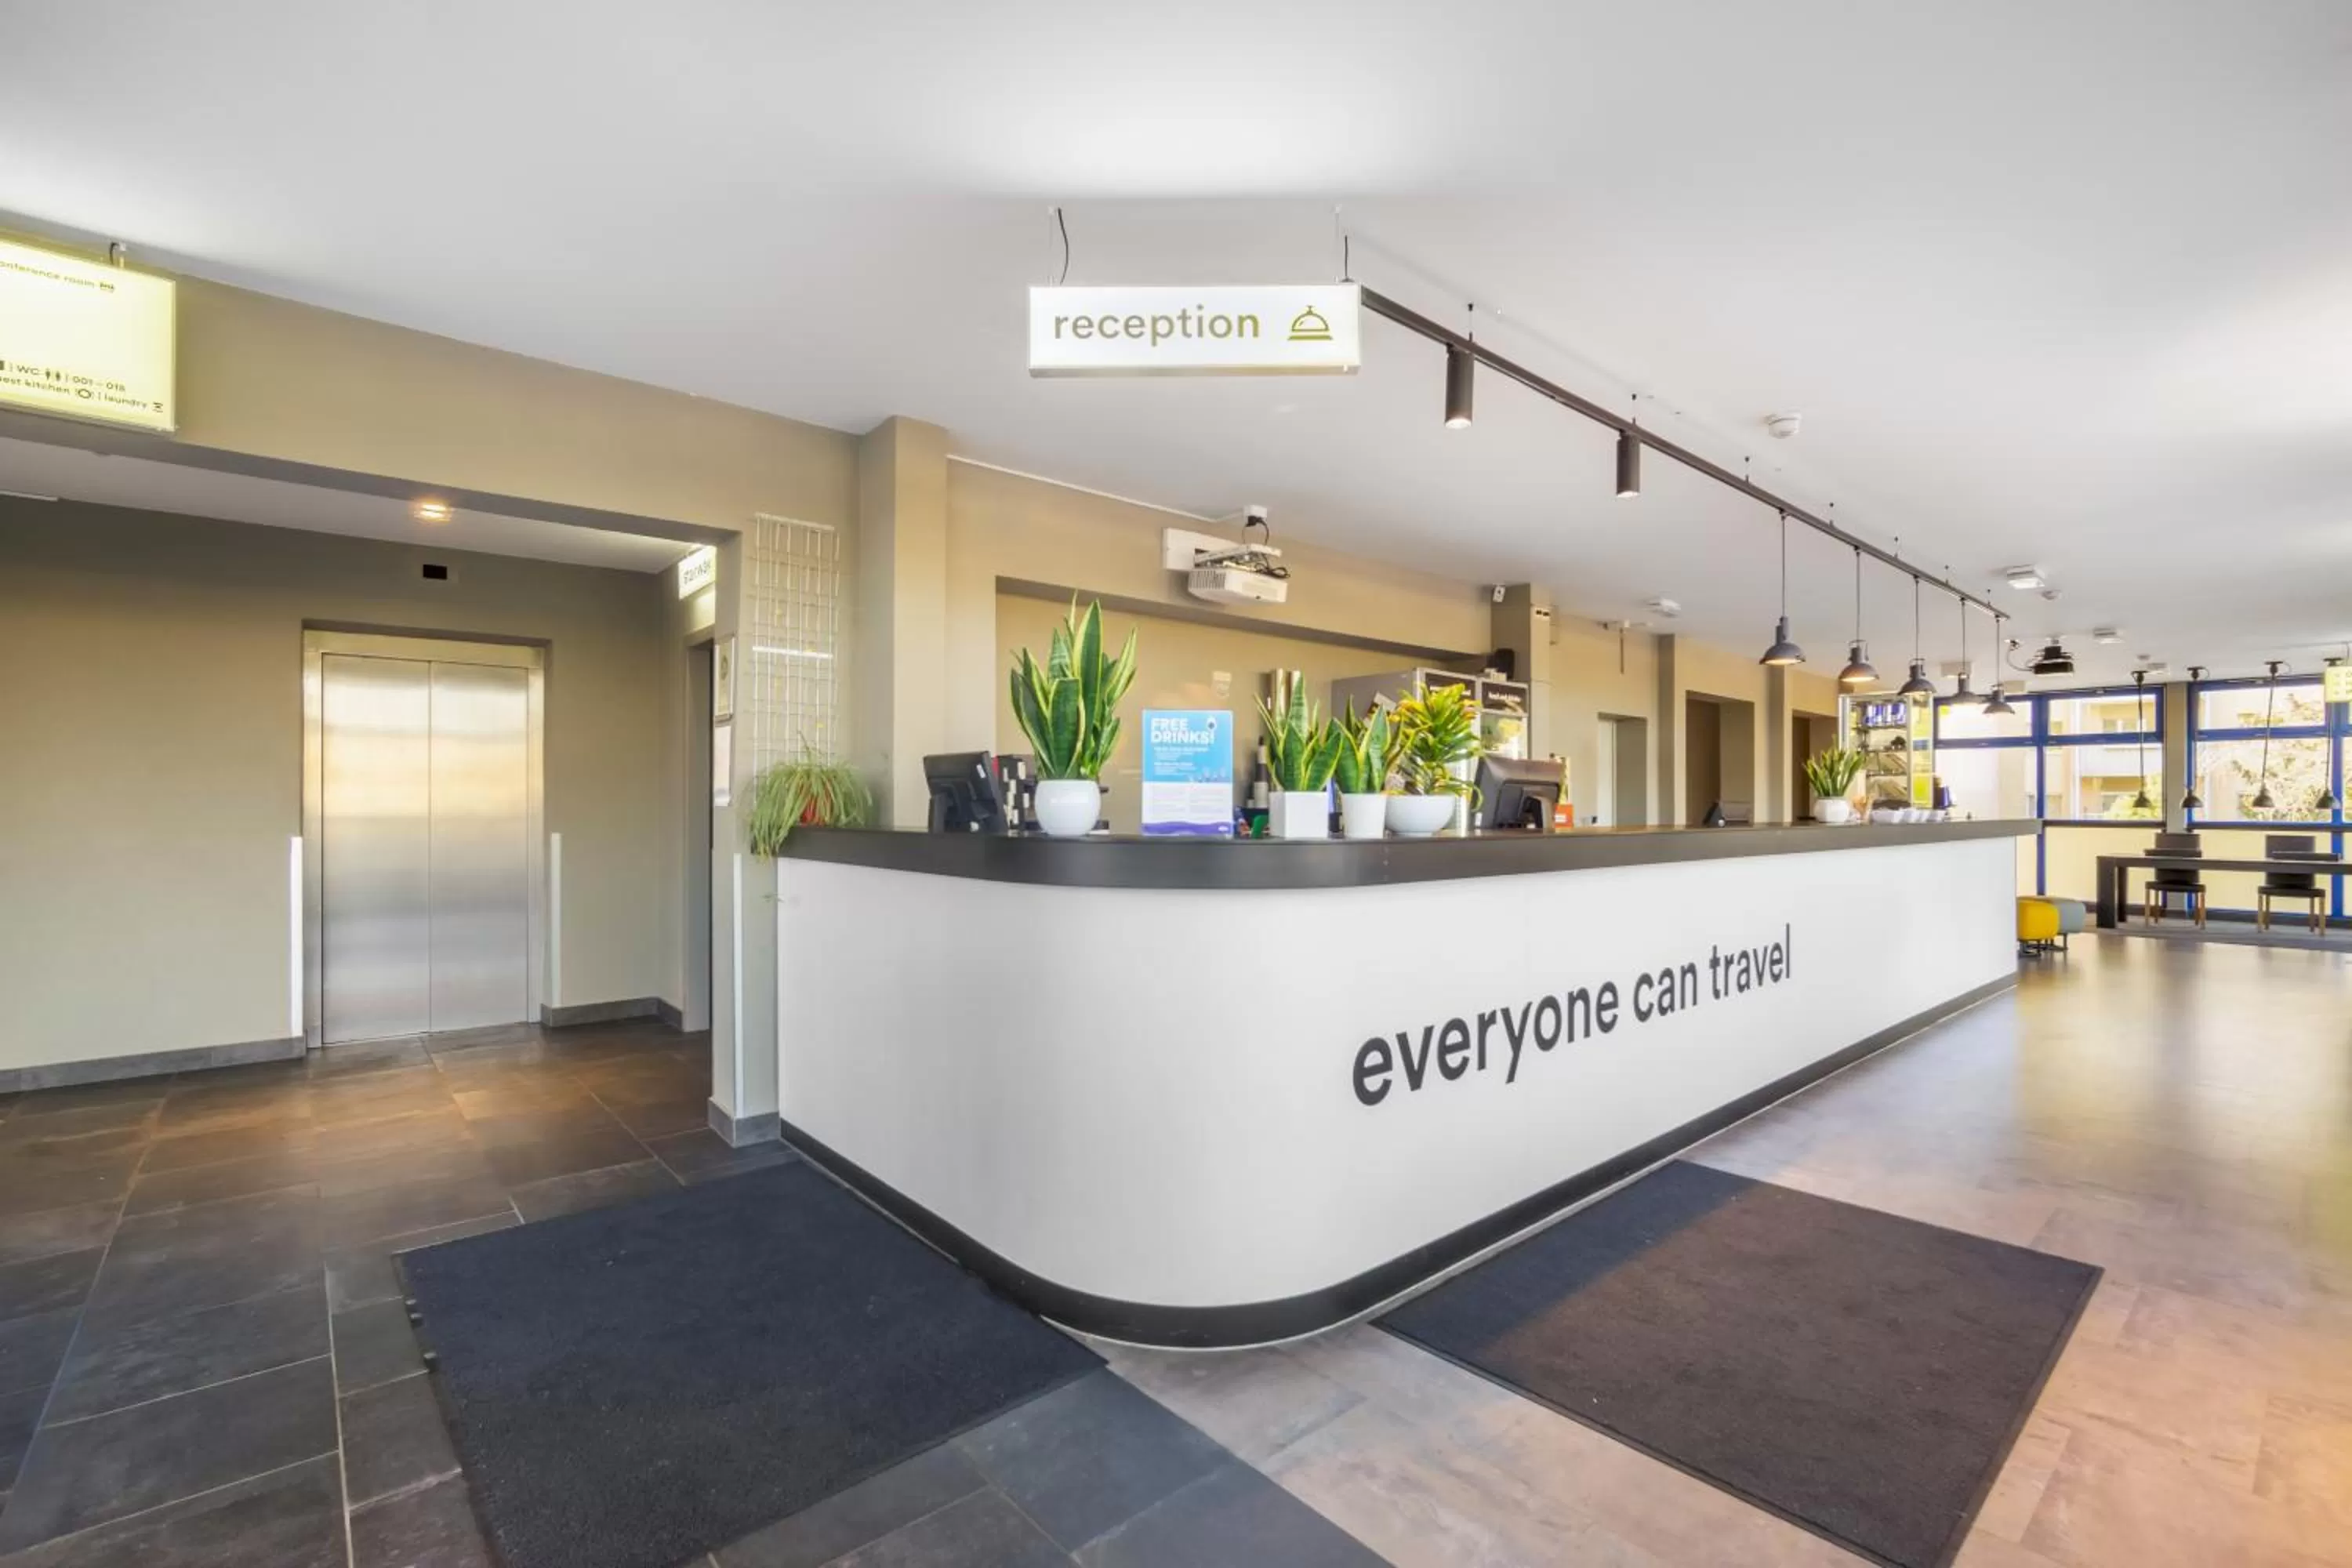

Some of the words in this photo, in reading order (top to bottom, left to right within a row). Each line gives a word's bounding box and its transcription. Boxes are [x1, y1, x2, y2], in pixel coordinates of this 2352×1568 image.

[1054, 303, 1260, 347] reception
[16, 365, 39, 376] WC
[24, 379, 71, 395] kitchen
[104, 393, 147, 410] laundry
[1151, 717, 1189, 731] FREE
[1352, 981, 1619, 1107] everyone
[1633, 960, 1698, 1022] can
[1708, 922, 1791, 1000] travel
